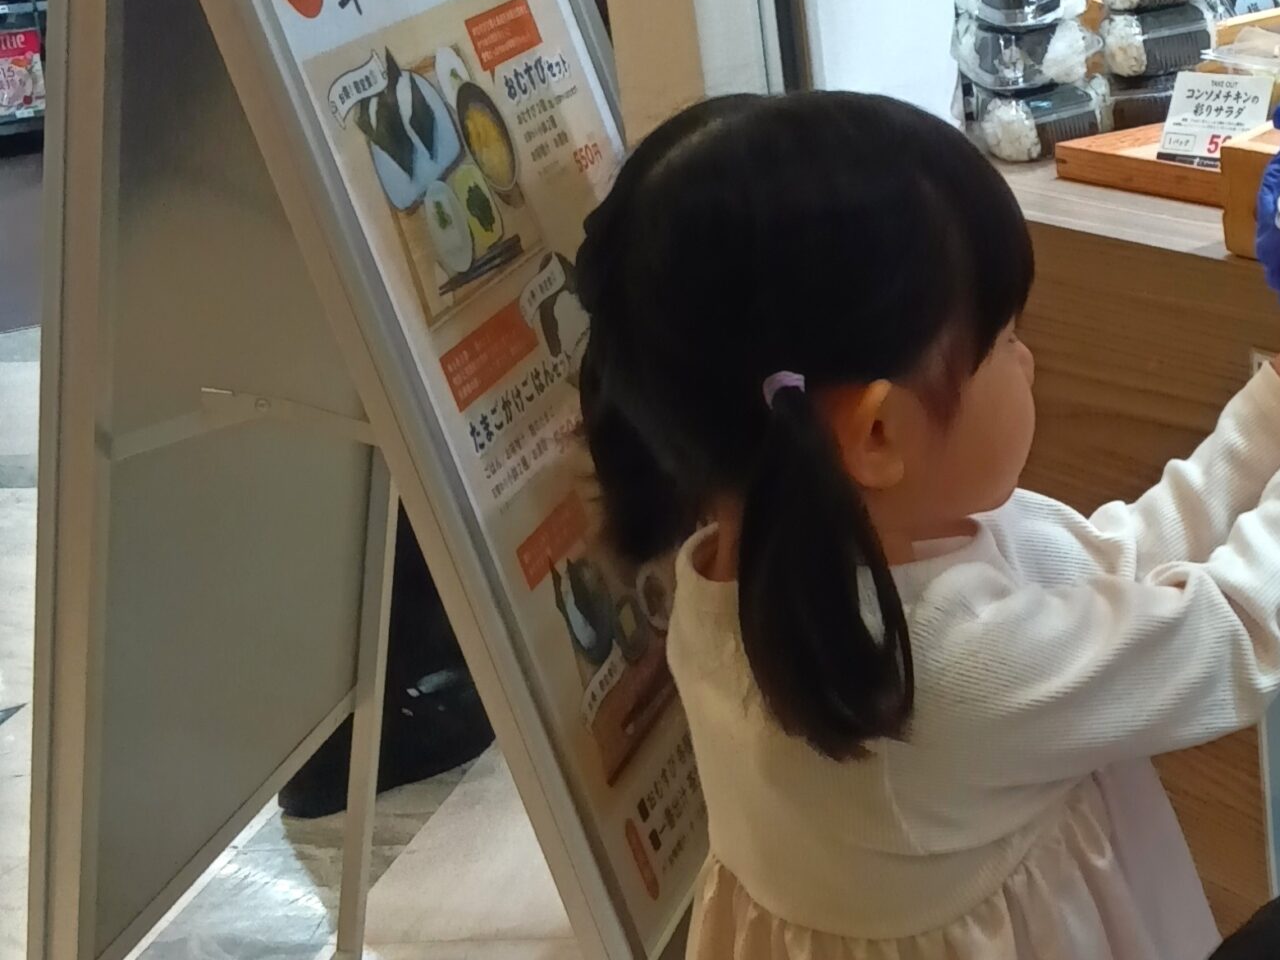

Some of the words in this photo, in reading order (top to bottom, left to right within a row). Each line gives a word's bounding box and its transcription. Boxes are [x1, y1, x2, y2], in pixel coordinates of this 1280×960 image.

[1186, 89, 1260, 105] コンソメチキンの
[1193, 103, 1246, 119] 彩りサラダ
